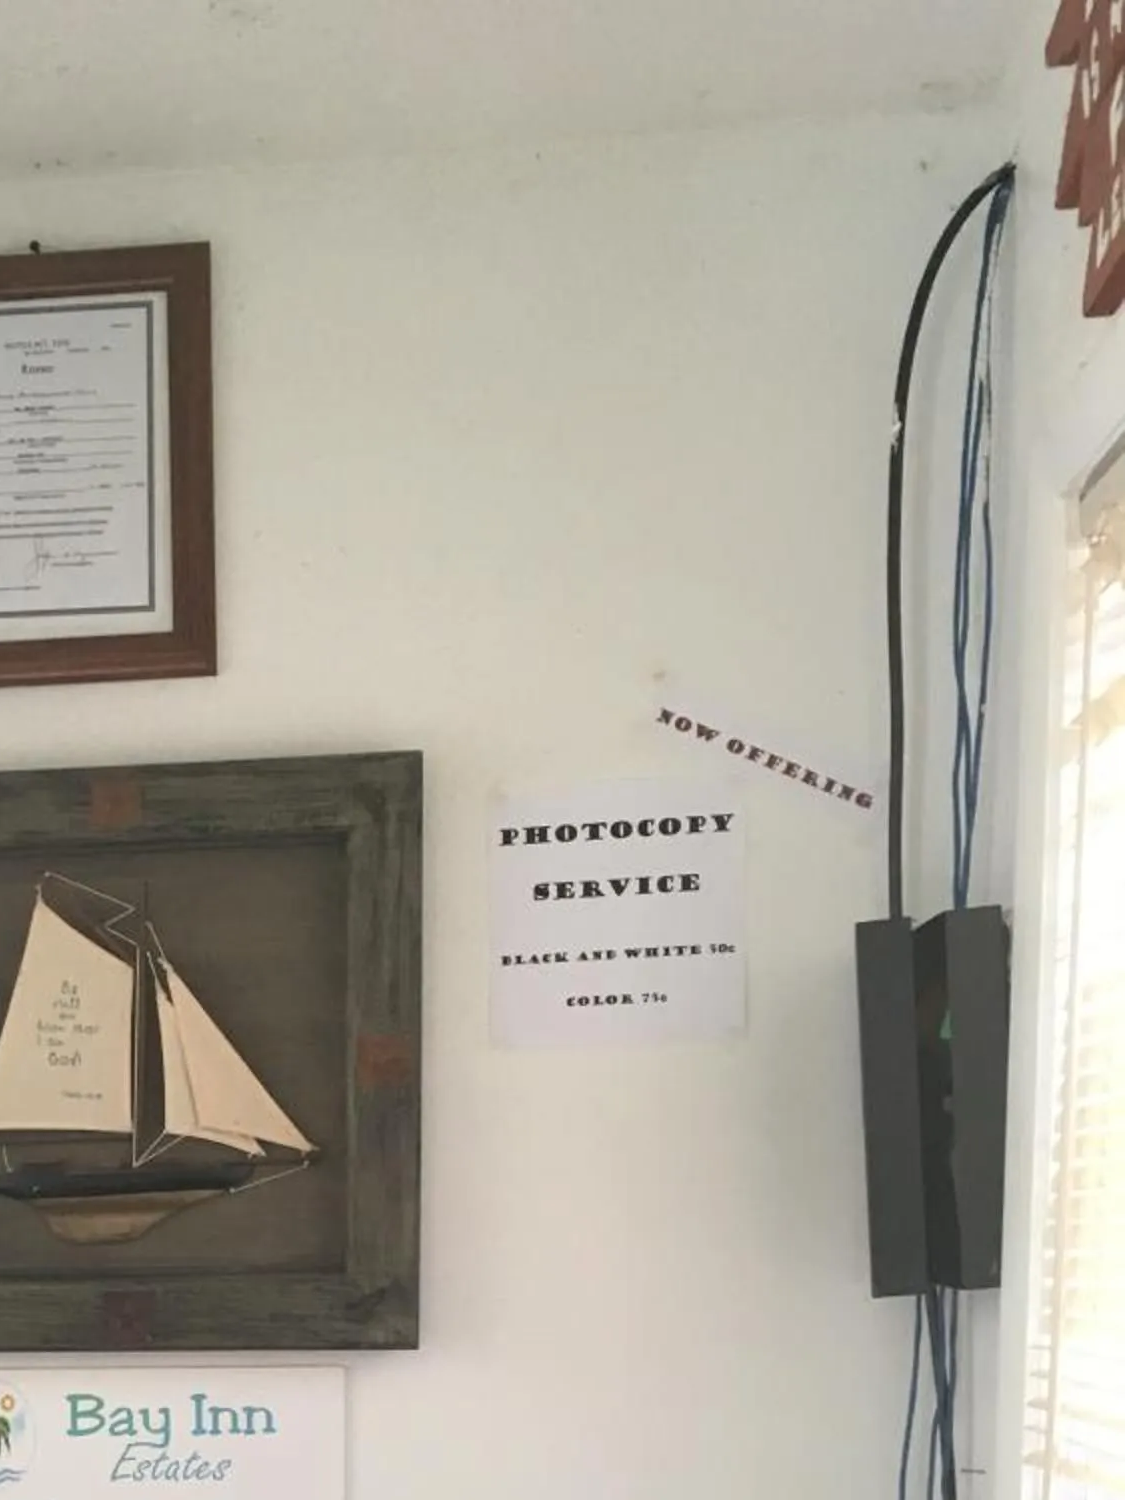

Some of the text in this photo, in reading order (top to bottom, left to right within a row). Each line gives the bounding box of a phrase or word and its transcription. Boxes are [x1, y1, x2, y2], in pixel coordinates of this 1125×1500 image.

[656, 708, 873, 809] NOW OFFERING
[499, 813, 734, 847] PHOTOCOPY
[533, 873, 701, 901] SERVICE
[501, 951, 569, 966] BLACK
[578, 949, 616, 961] AND
[625, 945, 702, 959] WHITE
[566, 994, 633, 1007] COLOR
[66, 1393, 277, 1448] Bay Inn
[110, 1442, 231, 1482] Estates
